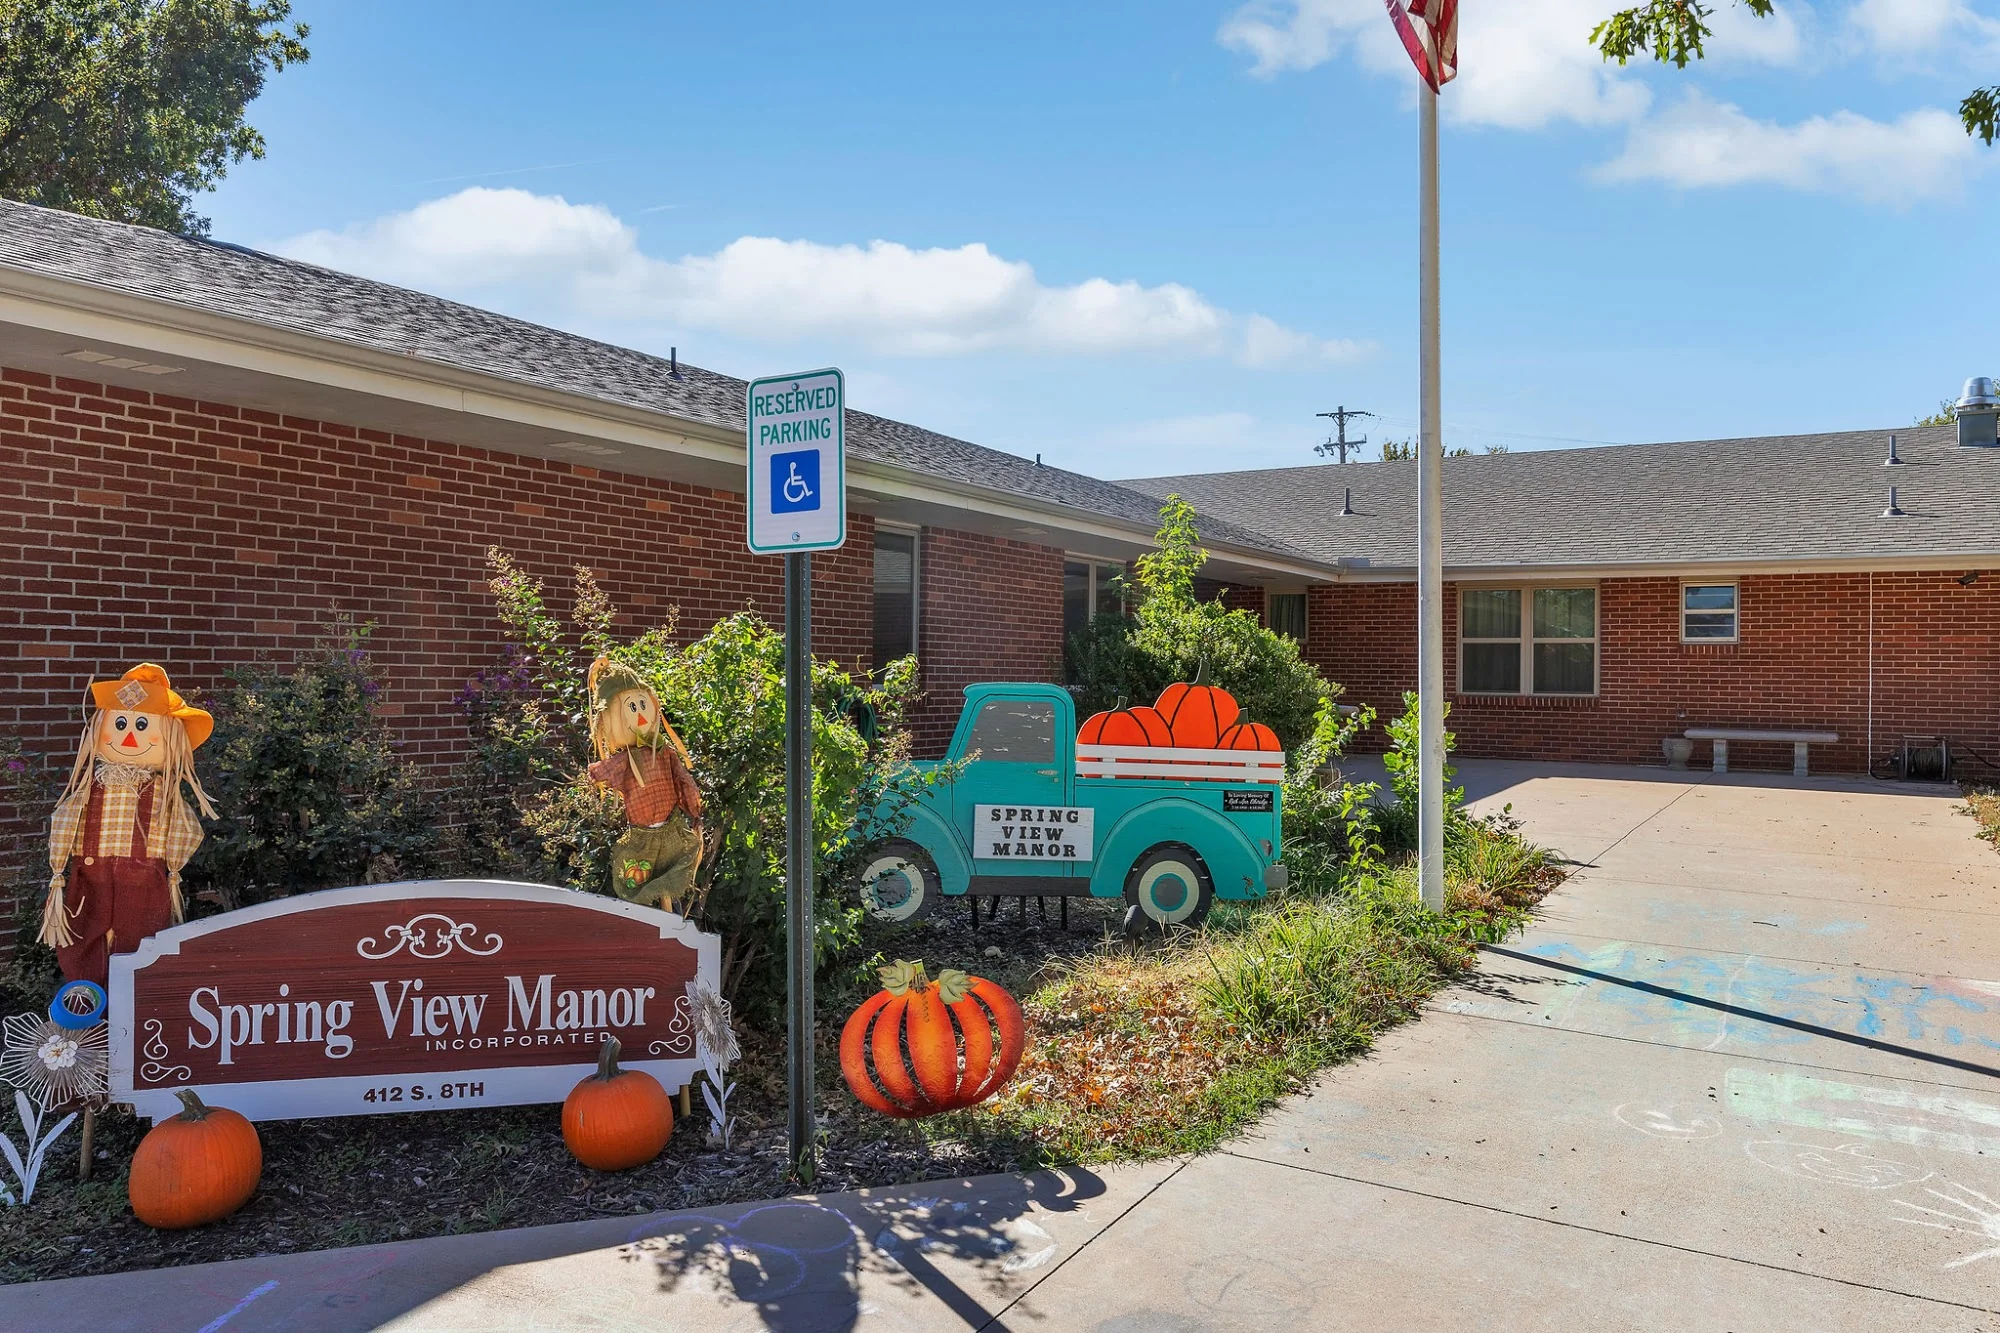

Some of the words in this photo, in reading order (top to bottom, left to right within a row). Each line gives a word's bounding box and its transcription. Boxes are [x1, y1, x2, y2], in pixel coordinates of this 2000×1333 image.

[755, 386, 836, 417] RESERVED
[760, 417, 831, 446] PARKING
[991, 808, 1079, 823] SPRING
[1002, 826, 1064, 841] VIEW
[992, 843, 1076, 857] MANOR
[188, 984, 354, 1065] Spring
[370, 978, 488, 1039] View
[503, 974, 655, 1032] Manor
[426, 1032, 611, 1051] INCORPORATED
[363, 1087, 403, 1103] 412
[410, 1085, 432, 1101] S.
[440, 1082, 484, 1099] 8TH
